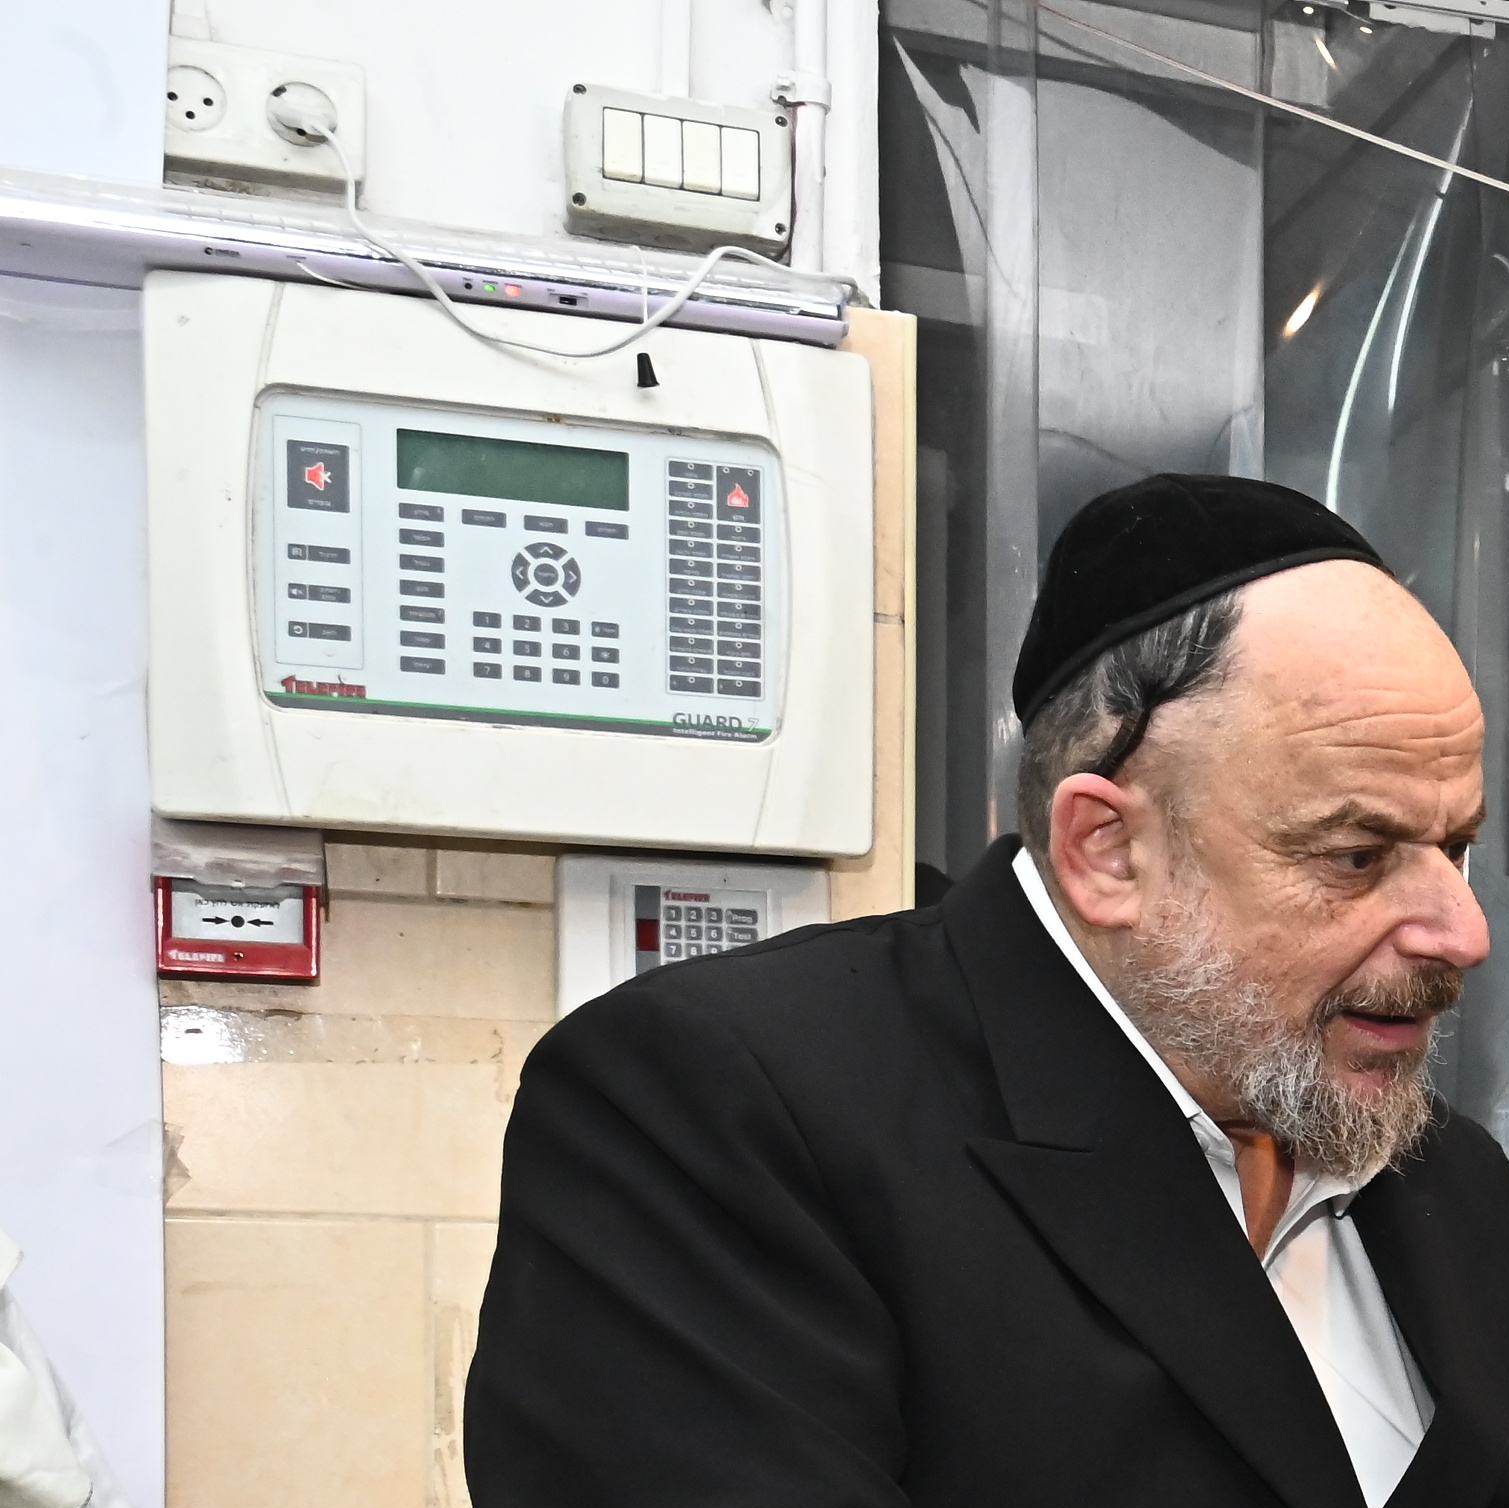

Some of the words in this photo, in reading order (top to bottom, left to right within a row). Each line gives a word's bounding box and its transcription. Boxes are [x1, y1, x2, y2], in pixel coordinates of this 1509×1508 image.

[672, 712, 743, 729] GUARD
[673, 728, 715, 738] Intelligent
[717, 730, 732, 738] Fire
[734, 732, 758, 740] Alarm
[734, 932, 752, 940] Test
